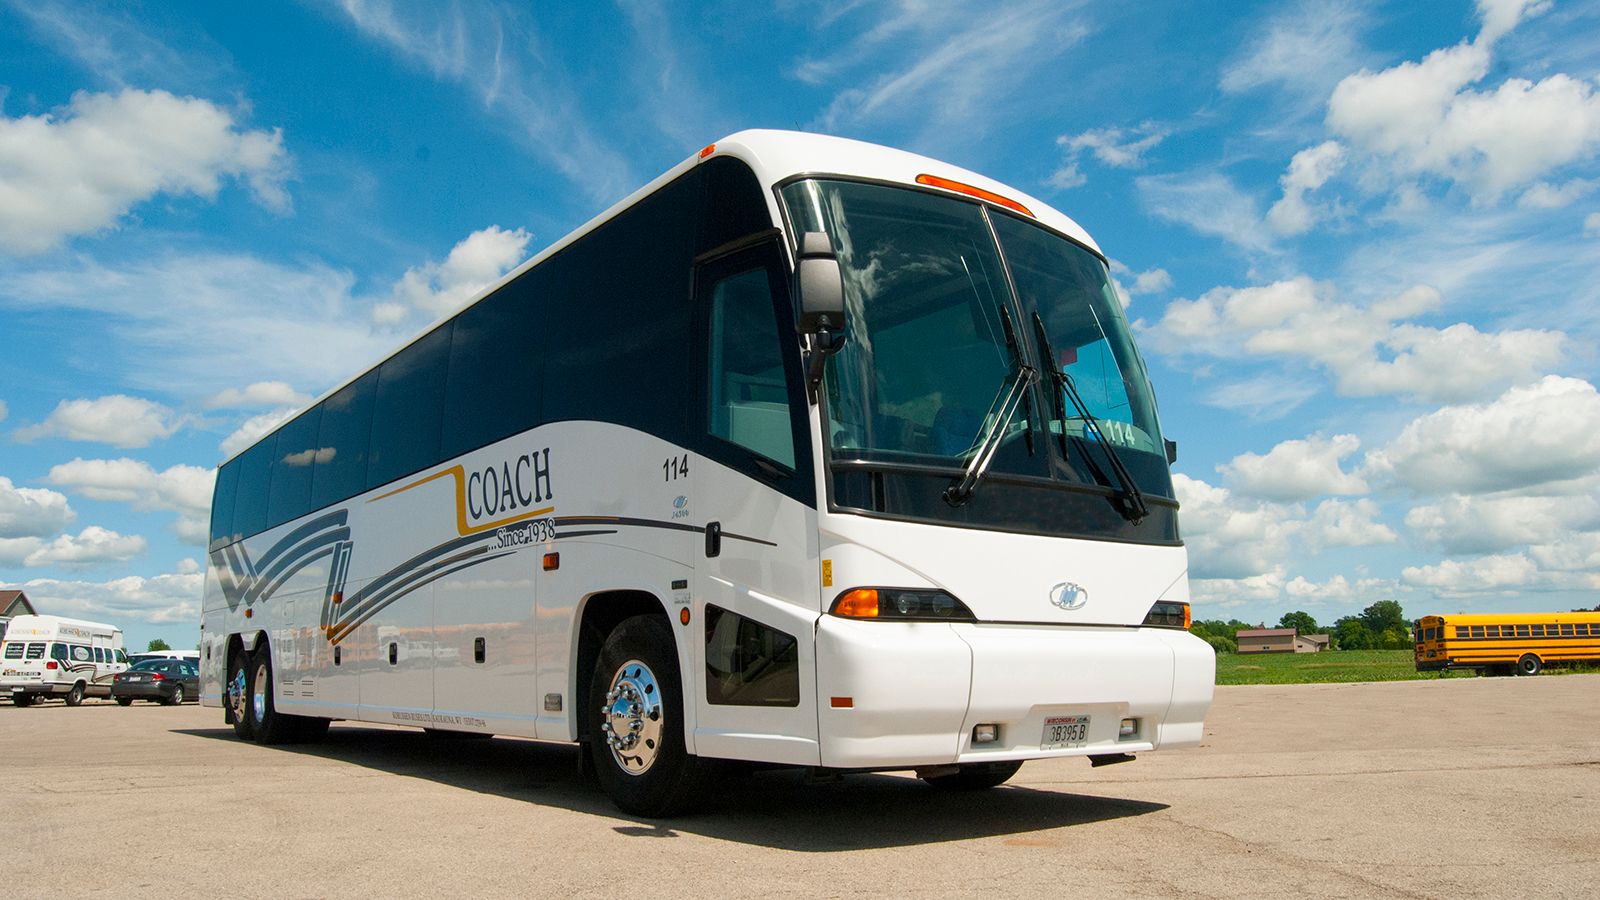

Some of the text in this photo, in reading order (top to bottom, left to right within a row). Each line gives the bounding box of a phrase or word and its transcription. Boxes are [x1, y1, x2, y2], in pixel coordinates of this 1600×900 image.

[1106, 419, 1135, 445] 114
[663, 453, 689, 482] 114
[468, 447, 552, 519] COACH
[526, 518, 555, 543] 1938
